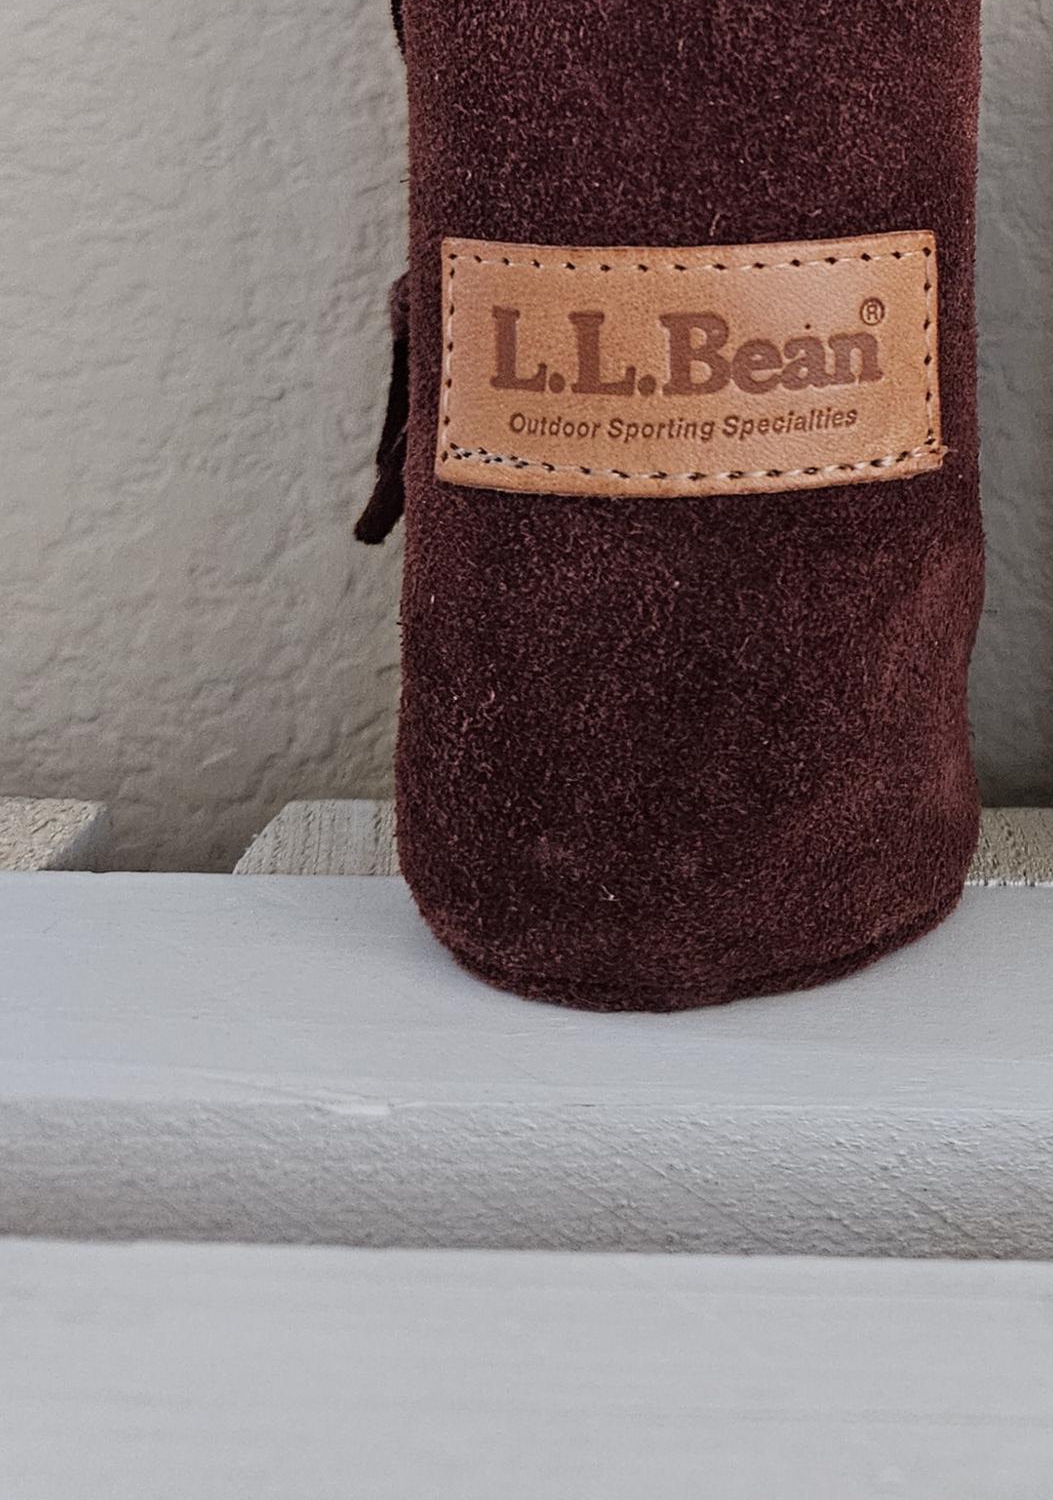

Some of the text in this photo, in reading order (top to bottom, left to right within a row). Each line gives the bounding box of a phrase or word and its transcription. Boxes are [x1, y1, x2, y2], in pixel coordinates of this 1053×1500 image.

[509, 407, 859, 442] Outdoor Sporting Specialties
